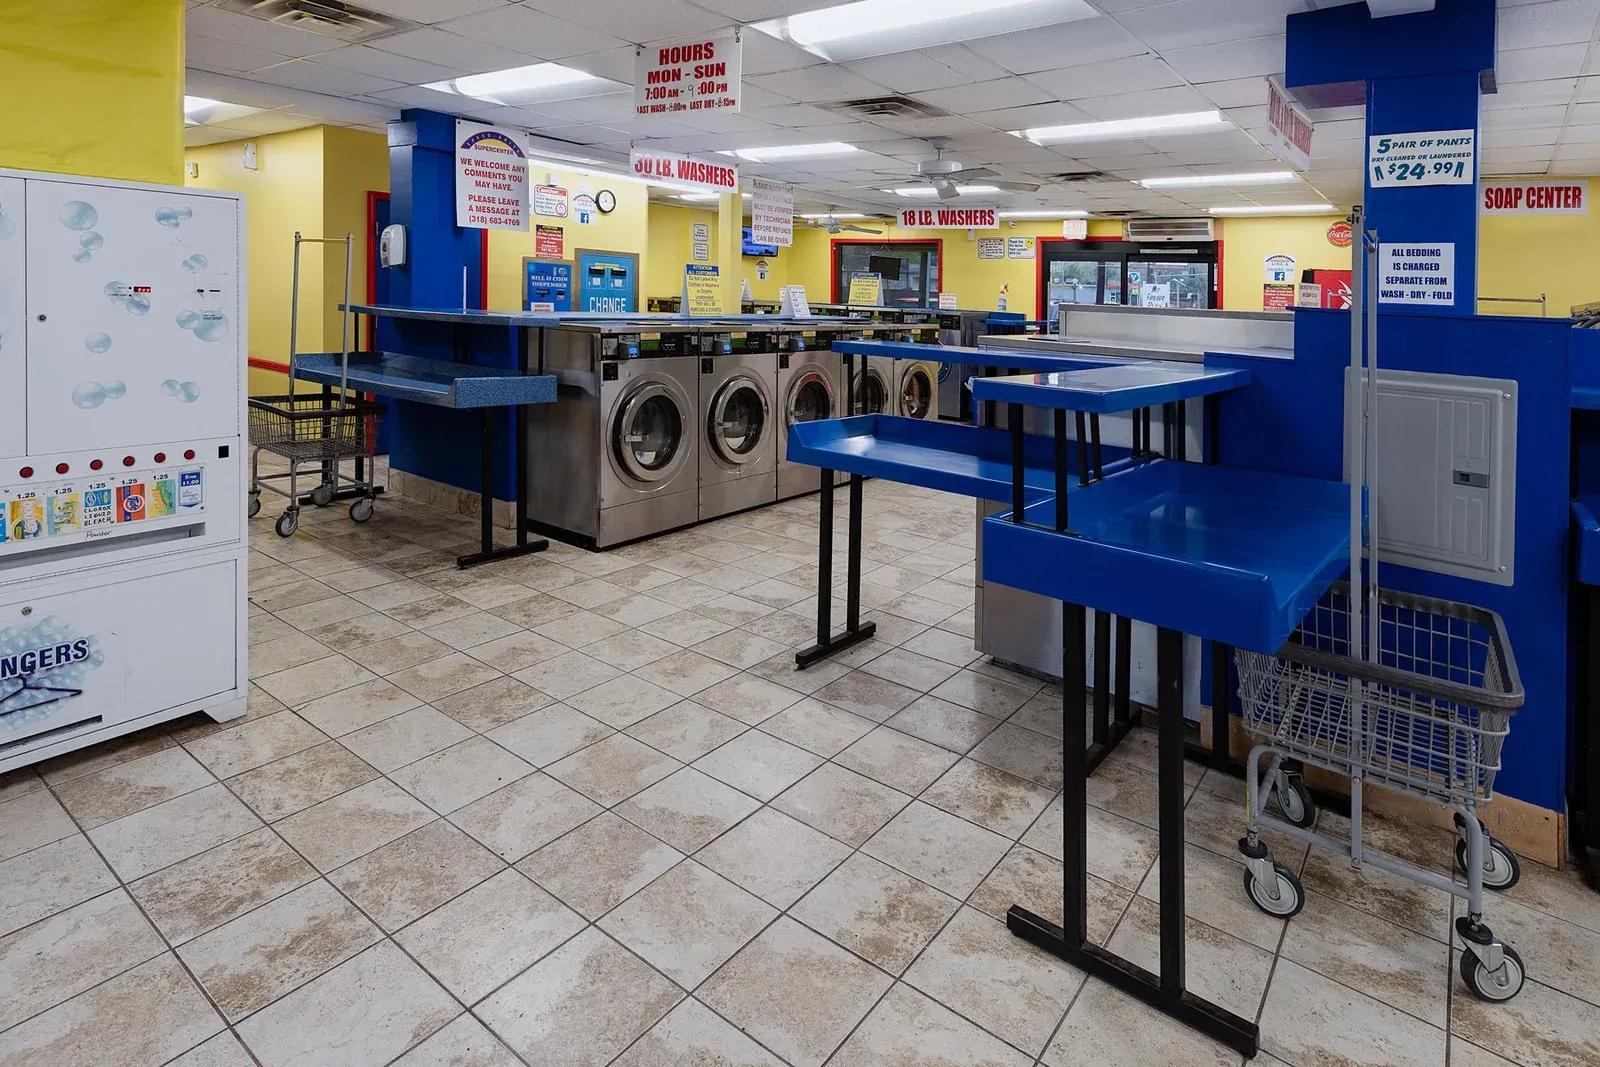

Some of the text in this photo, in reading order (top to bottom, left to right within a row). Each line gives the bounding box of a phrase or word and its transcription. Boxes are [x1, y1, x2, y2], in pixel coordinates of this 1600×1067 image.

[659, 42, 714, 65] HOURS
[648, 68, 681, 84] MON
[694, 62, 726, 79] SUN
[645, 87, 666, 100] 7:00
[668, 89, 678, 98] AM
[716, 83, 727, 92] PM
[637, 105, 648, 114] LAST
[690, 101, 702, 109] LAST
[474, 144, 514, 155] SUPERCENTER
[1377, 138, 1392, 154] 5
[1392, 141, 1417, 149] PAIR
[1436, 137, 1472, 146] PANTS
[460, 158, 472, 166] WE
[474, 160, 510, 170] WELCOME
[464, 169, 522, 182] COMMENTS YOU
[634, 153, 734, 188] 30 LB. WASHERS
[1388, 161, 1453, 180] $24.99
[493, 183, 513, 191] HAVE.
[469, 195, 519, 206] PLEASE LEAVE
[1485, 186, 1582, 209] SOAP CENTER
[476, 206, 509, 215] MESSAGE
[469, 215, 520, 226] (318) 683-4769
[763, 215, 790, 224] TECHNICIAN
[902, 209, 995, 226] 18 LB. WASHERS
[1406, 249, 1441, 257] BEDDING
[1403, 262, 1440, 271] CHARGED
[1386, 276, 1447, 285] SEPARATE FROM
[1381, 290, 1404, 298] WASH
[1432, 291, 1452, 299] FOLD
[590, 297, 626, 313] CHANGE
[84, 505, 111, 513] CLOROX
[127, 496, 141, 510] Tide
[84, 517, 111, 526] BLEACH
